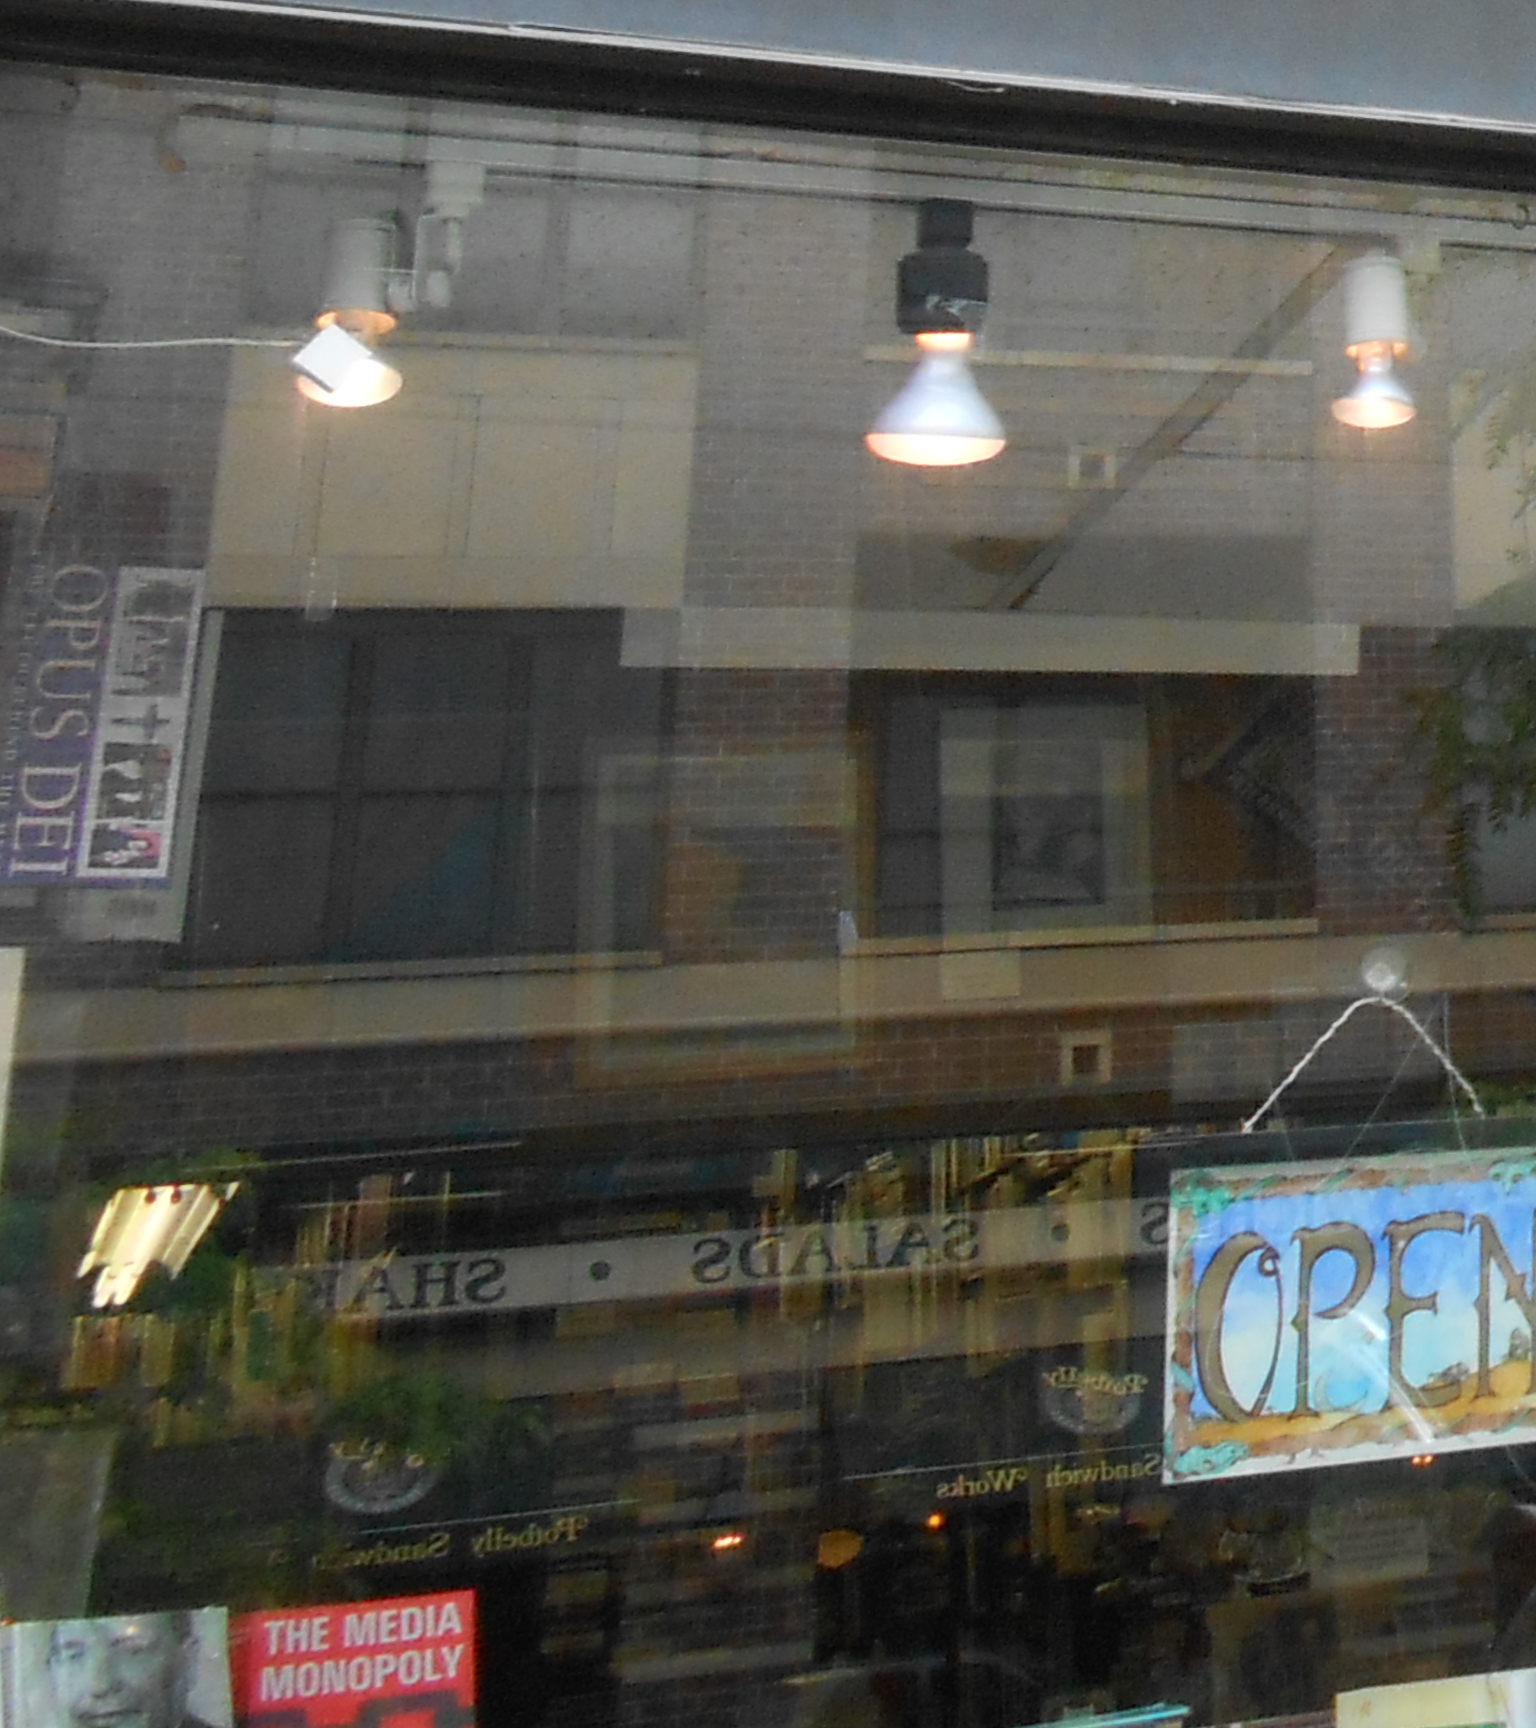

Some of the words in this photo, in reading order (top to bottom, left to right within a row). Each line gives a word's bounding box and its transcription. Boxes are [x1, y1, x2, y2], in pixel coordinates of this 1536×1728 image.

[29, 563, 108, 740] OPUS
[10, 762, 83, 877] DEI
[260, 1643, 465, 1702] MONOPOLY
[264, 1616, 332, 1656] THE
[343, 1602, 463, 1648] MEDIA
